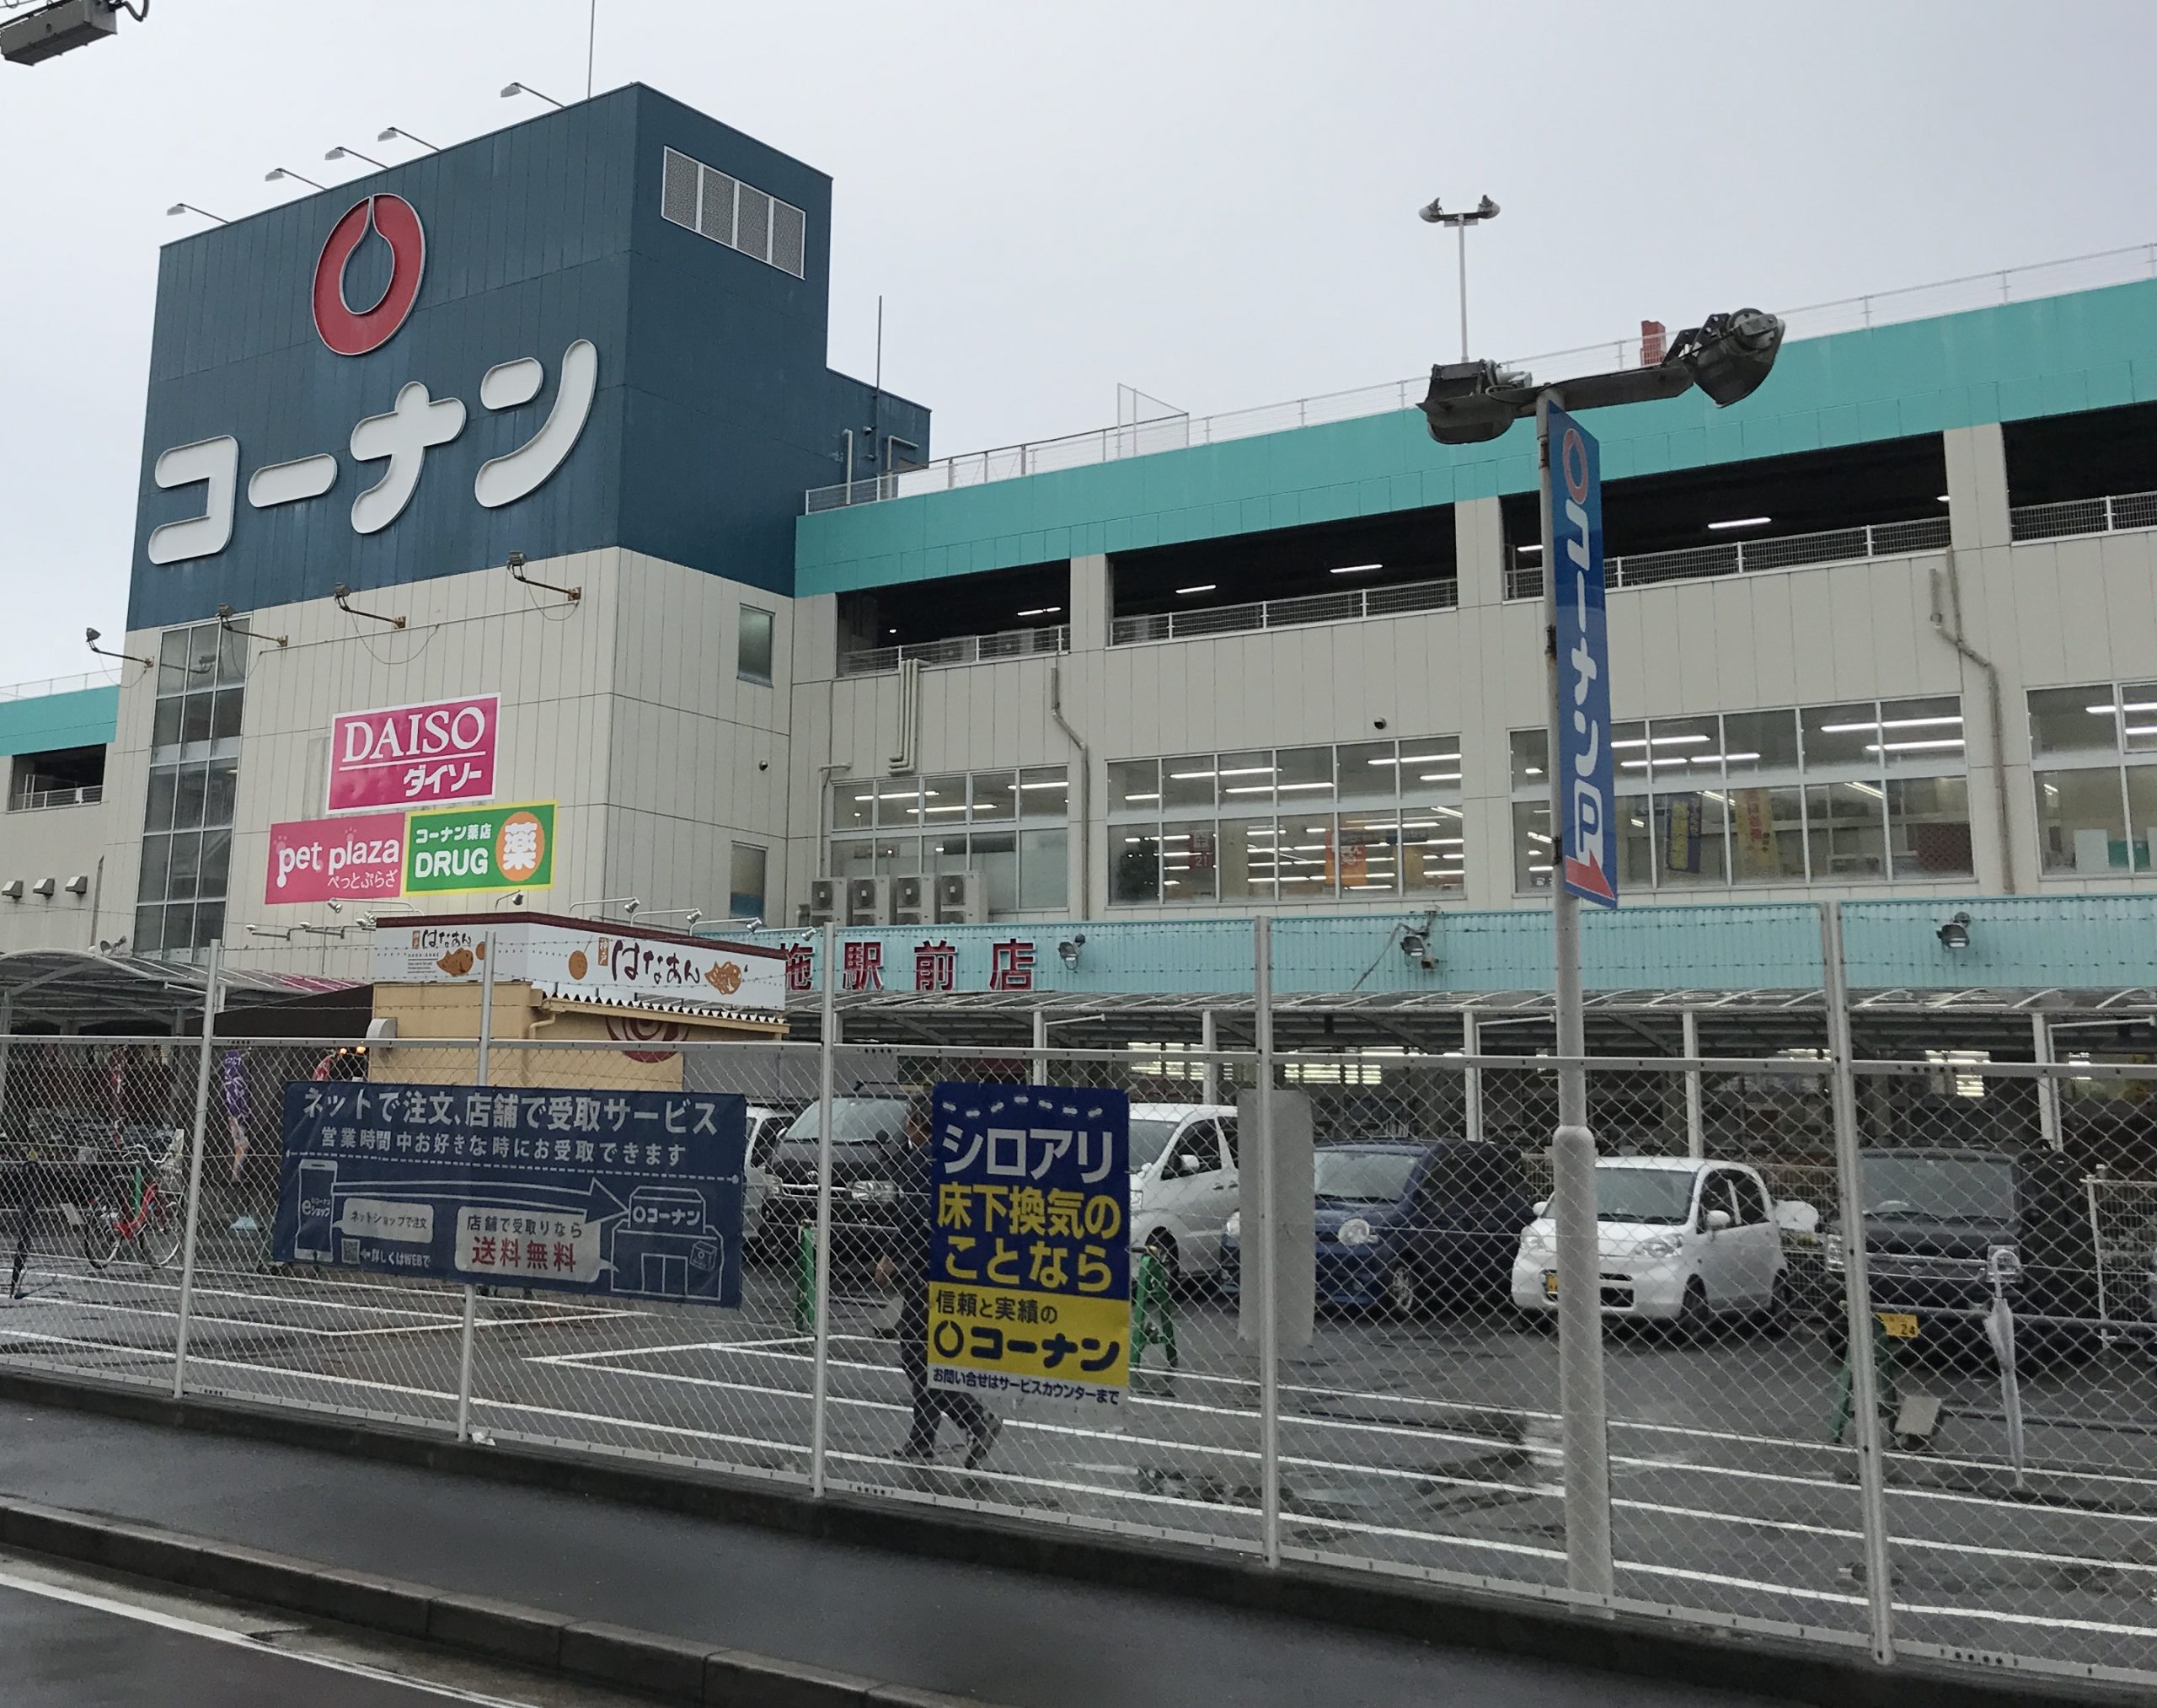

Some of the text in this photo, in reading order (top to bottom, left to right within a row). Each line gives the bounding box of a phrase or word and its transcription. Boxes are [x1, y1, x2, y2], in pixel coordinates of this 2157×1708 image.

[148, 339, 597, 565] コーナン
[1566, 499, 1598, 777] コーナン
[342, 706, 486, 763] DAISO
[404, 762, 482, 796] ダイソー
[415, 823, 492, 843] コーナン薬店
[503, 822, 538, 870] 薬
[276, 838, 399, 887] pet plaza
[327, 869, 399, 891] ぺっとぷらざ
[415, 848, 488, 878] DRUG
[303, 1087, 717, 1135] ネットで注文、店舗で受取サービス
[322, 1127, 686, 1166] 営業時間中お好きな時にお受取できます
[942, 1124, 1112, 1183] シロアリ
[351, 1211, 428, 1230] ネットショップで注文
[467, 1215, 583, 1239] 店舗で受取りなら
[647, 1208, 701, 1226] コーナン
[937, 1182, 1121, 1240] 床下換気の
[471, 1236, 576, 1273] 送料無料
[945, 1235, 1111, 1292] ことなら
[935, 1289, 1057, 1325] 信頼と実績の
[971, 1326, 1120, 1373] コーナン
[933, 1368, 1120, 1405] お問い合せはサービスカウンターまで
